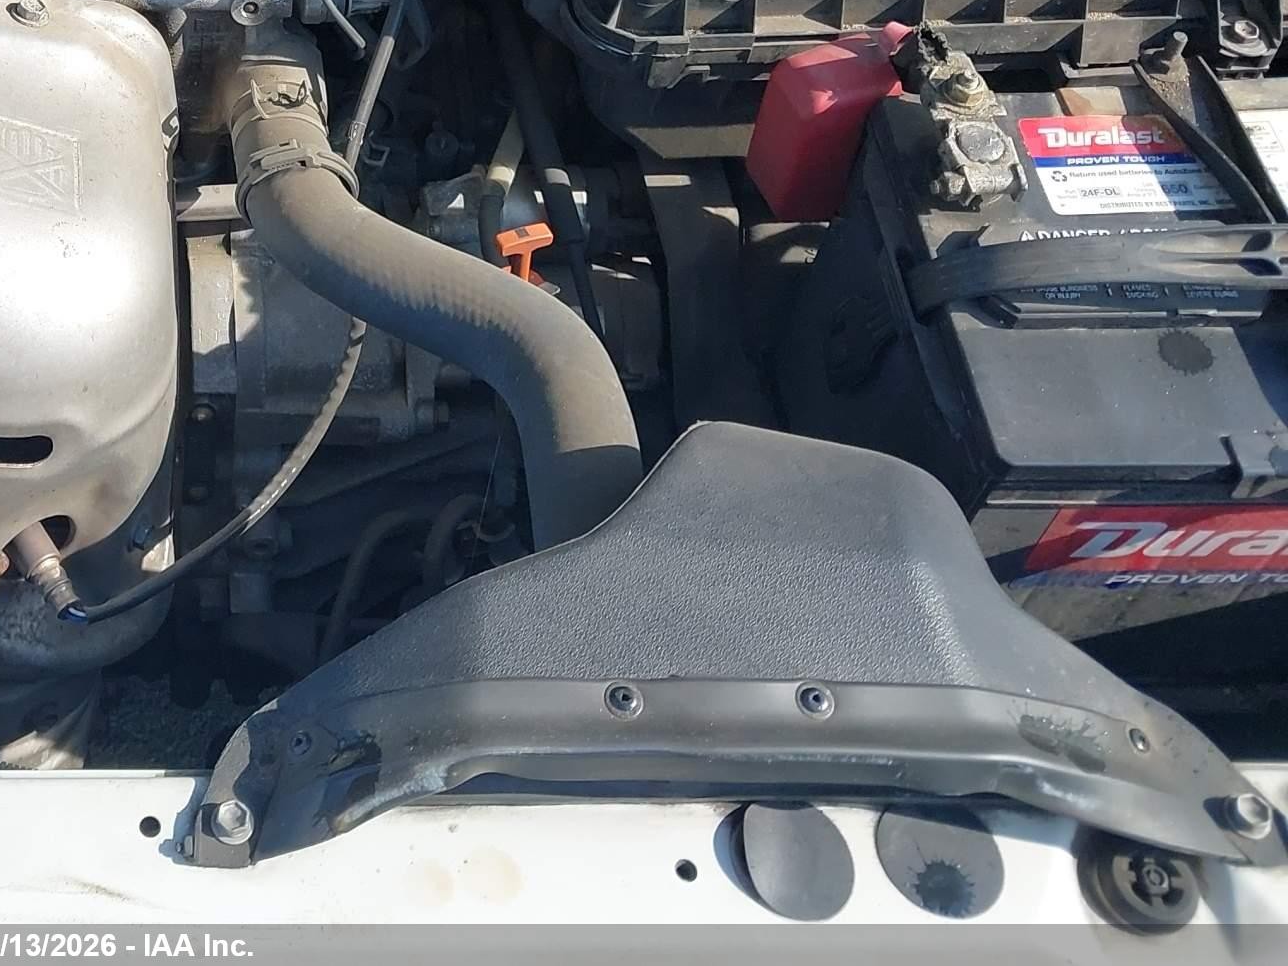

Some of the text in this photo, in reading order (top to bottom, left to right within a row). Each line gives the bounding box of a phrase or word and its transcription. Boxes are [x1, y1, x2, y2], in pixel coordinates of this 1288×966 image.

[1038, 124, 1165, 148] Duralast
[1067, 154, 1165, 165] PROVEN TOUGH
[1098, 169, 1117, 177] used
[1118, 167, 1153, 176] batteries
[1080, 187, 1121, 197] 24F-DL
[1070, 521, 1288, 558] Dura
[1106, 573, 1249, 585] PROVEN
